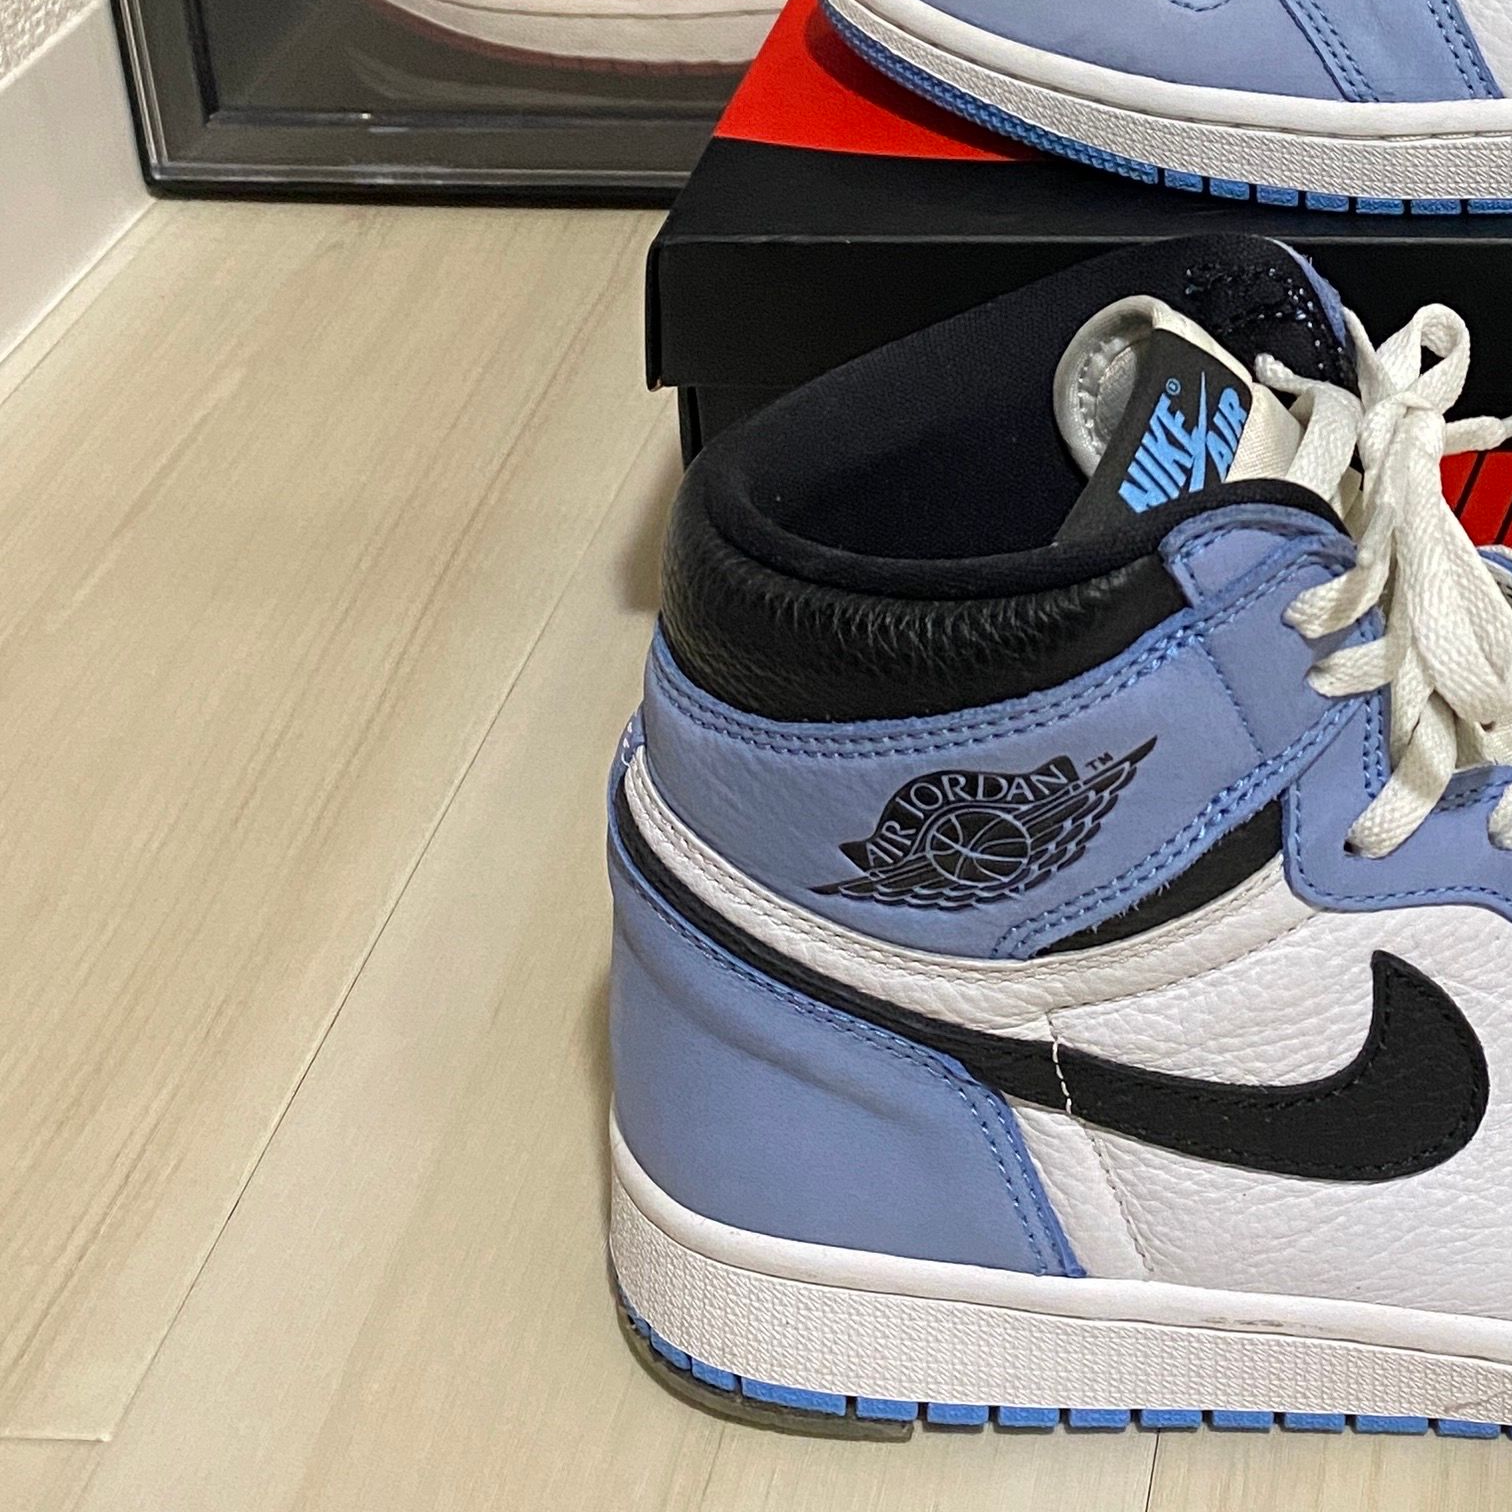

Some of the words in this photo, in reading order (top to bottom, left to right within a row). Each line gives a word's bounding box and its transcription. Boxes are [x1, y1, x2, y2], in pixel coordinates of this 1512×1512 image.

[1118, 393, 1202, 514] NIKE
[866, 819, 917, 866] AIR
[895, 763, 1068, 819] JORDAN
